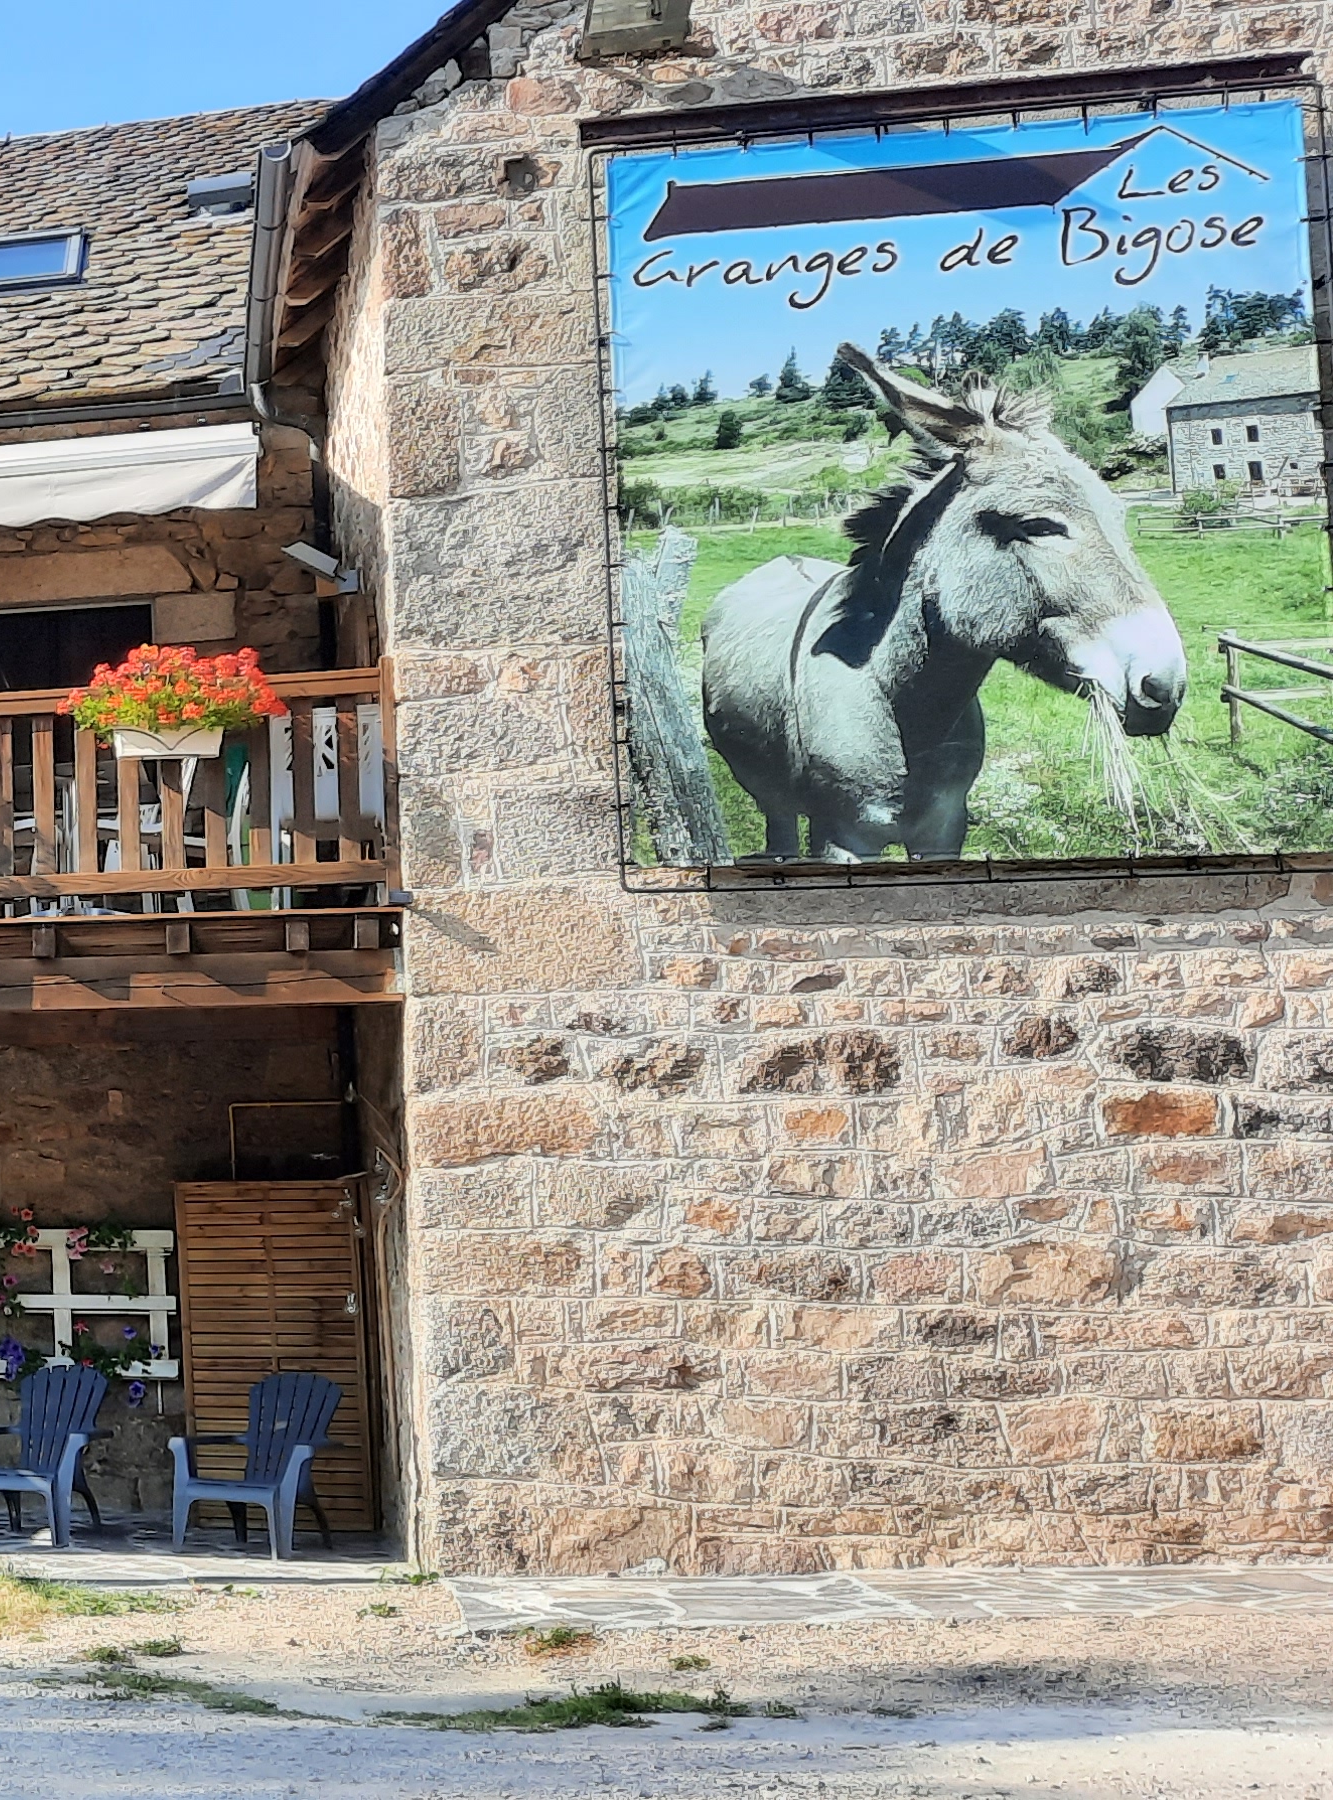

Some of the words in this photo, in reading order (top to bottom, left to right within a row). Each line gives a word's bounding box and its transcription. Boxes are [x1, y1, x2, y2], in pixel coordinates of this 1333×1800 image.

[1116, 163, 1221, 200] Les
[632, 241, 899, 310] Granges
[939, 227, 1020, 272] de
[1060, 205, 1265, 287] Bigose
